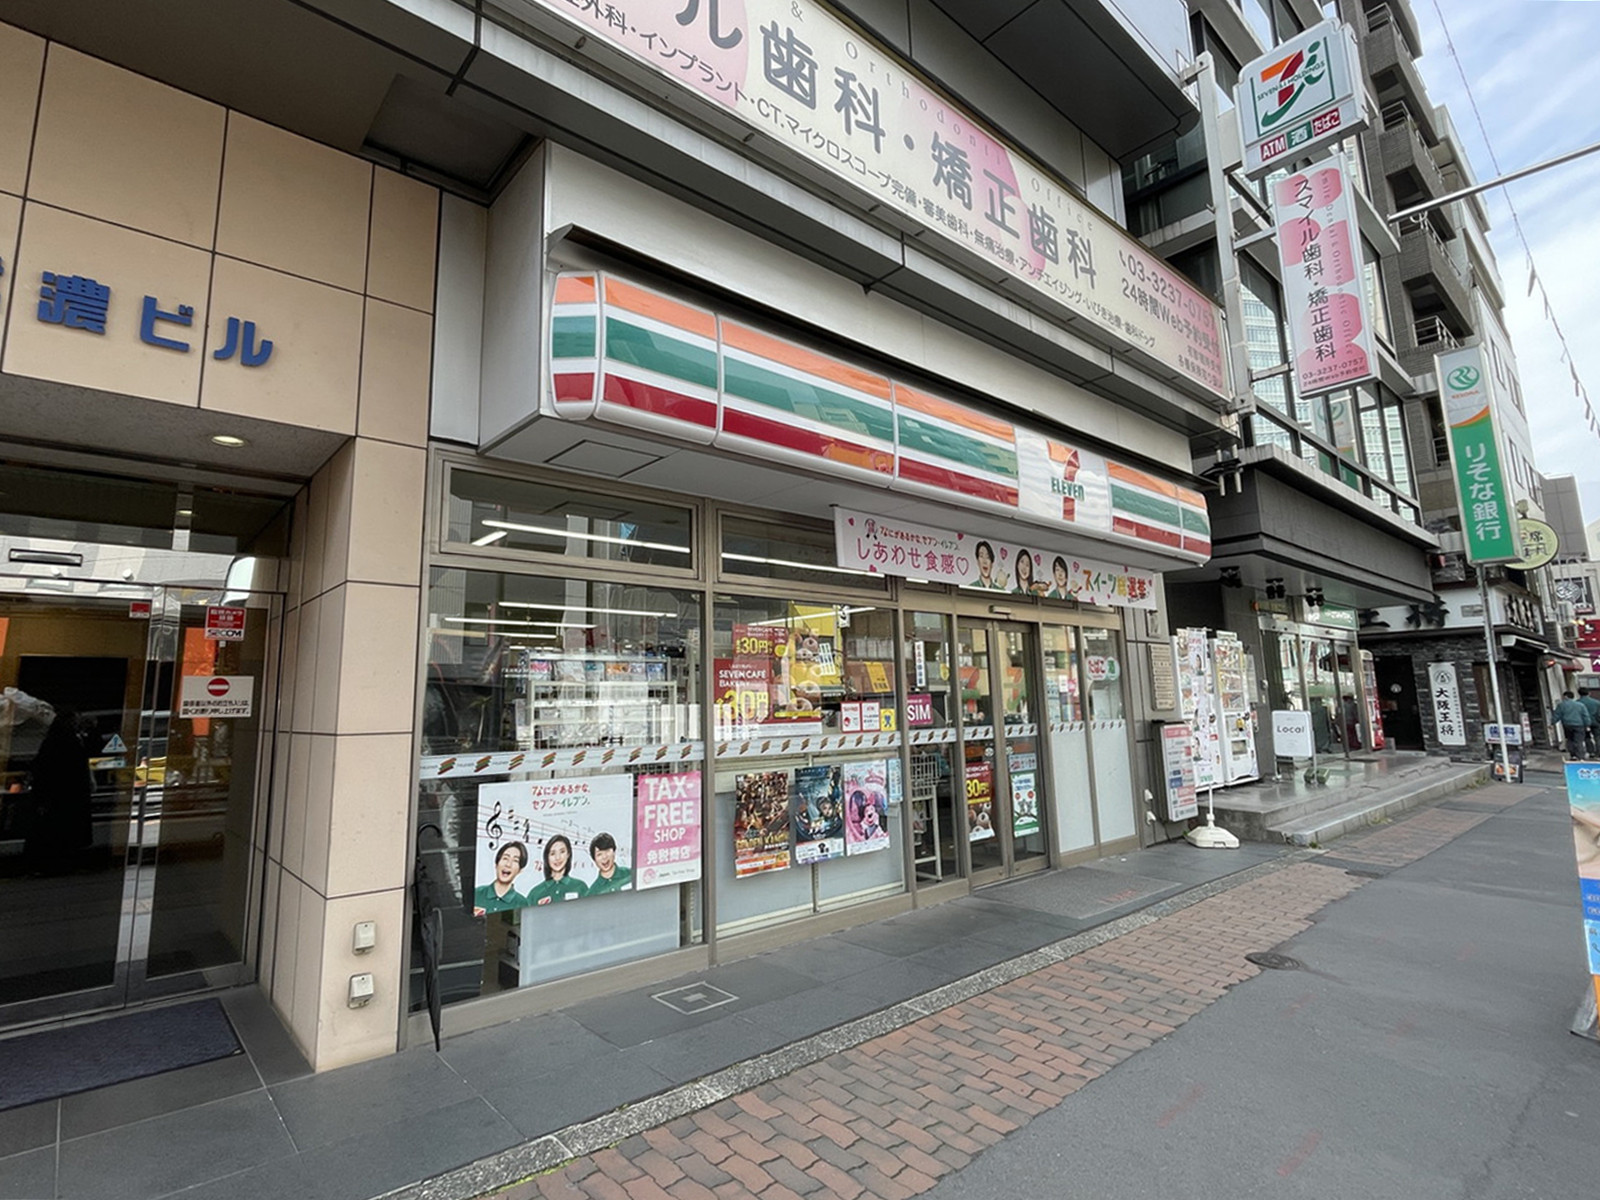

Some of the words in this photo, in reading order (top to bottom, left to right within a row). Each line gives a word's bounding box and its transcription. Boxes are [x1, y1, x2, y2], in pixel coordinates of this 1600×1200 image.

[1262, 137, 1286, 161] ATM
[1294, 178, 1336, 362] スマイル歯科・矯正歯科
[0, 257, 273, 367] 濃ビル
[1465, 442, 1502, 542] りそな銀行
[207, 629, 242, 638] SECOM
[907, 704, 931, 721] SIM
[1436, 687, 1454, 736] 大阪王将
[1276, 725, 1305, 734] Local
[644, 775, 694, 802] TAX-
[644, 800, 694, 829] FREE
[653, 827, 686, 844] SHOP
